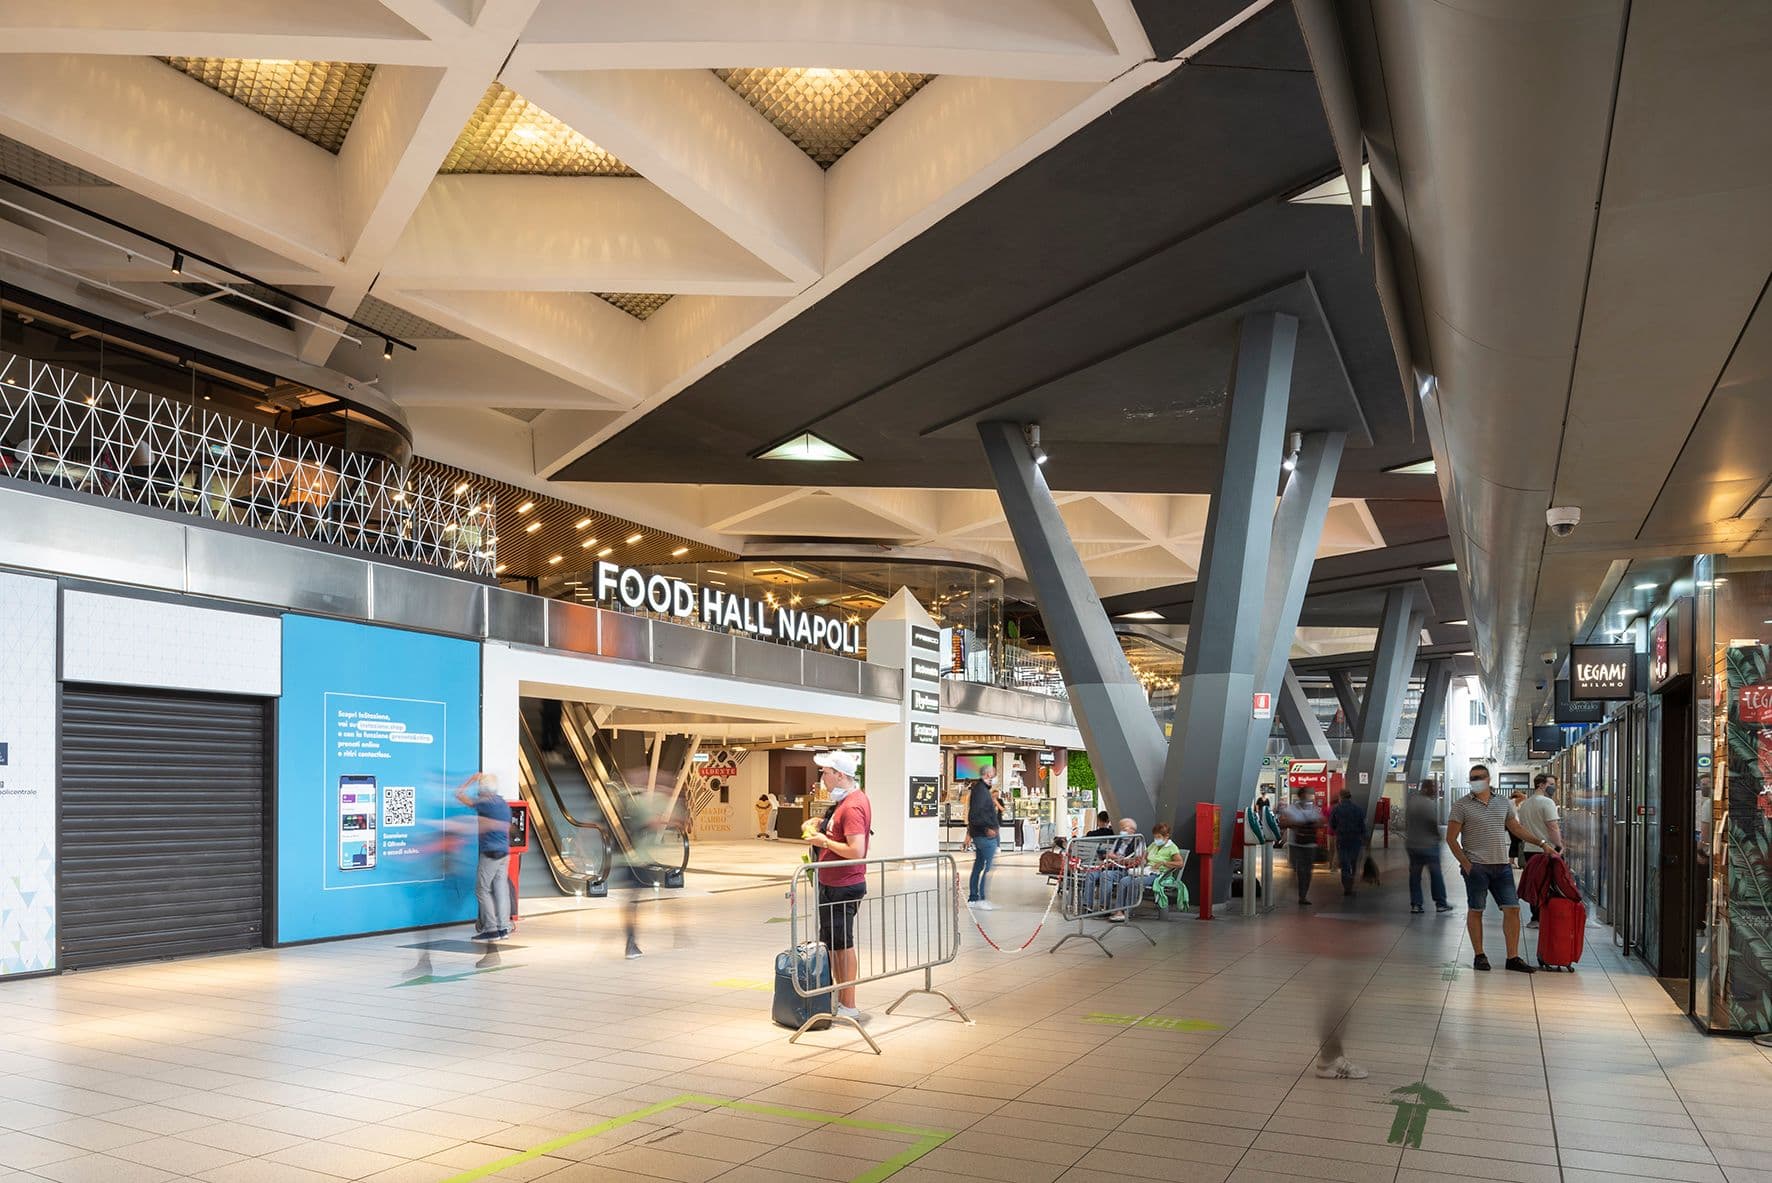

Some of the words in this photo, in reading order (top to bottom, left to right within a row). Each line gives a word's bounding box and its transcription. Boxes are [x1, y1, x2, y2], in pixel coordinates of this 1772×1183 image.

[598, 561, 694, 617] FOOD
[703, 588, 772, 635] HALL
[779, 607, 859, 654] NAPOLI
